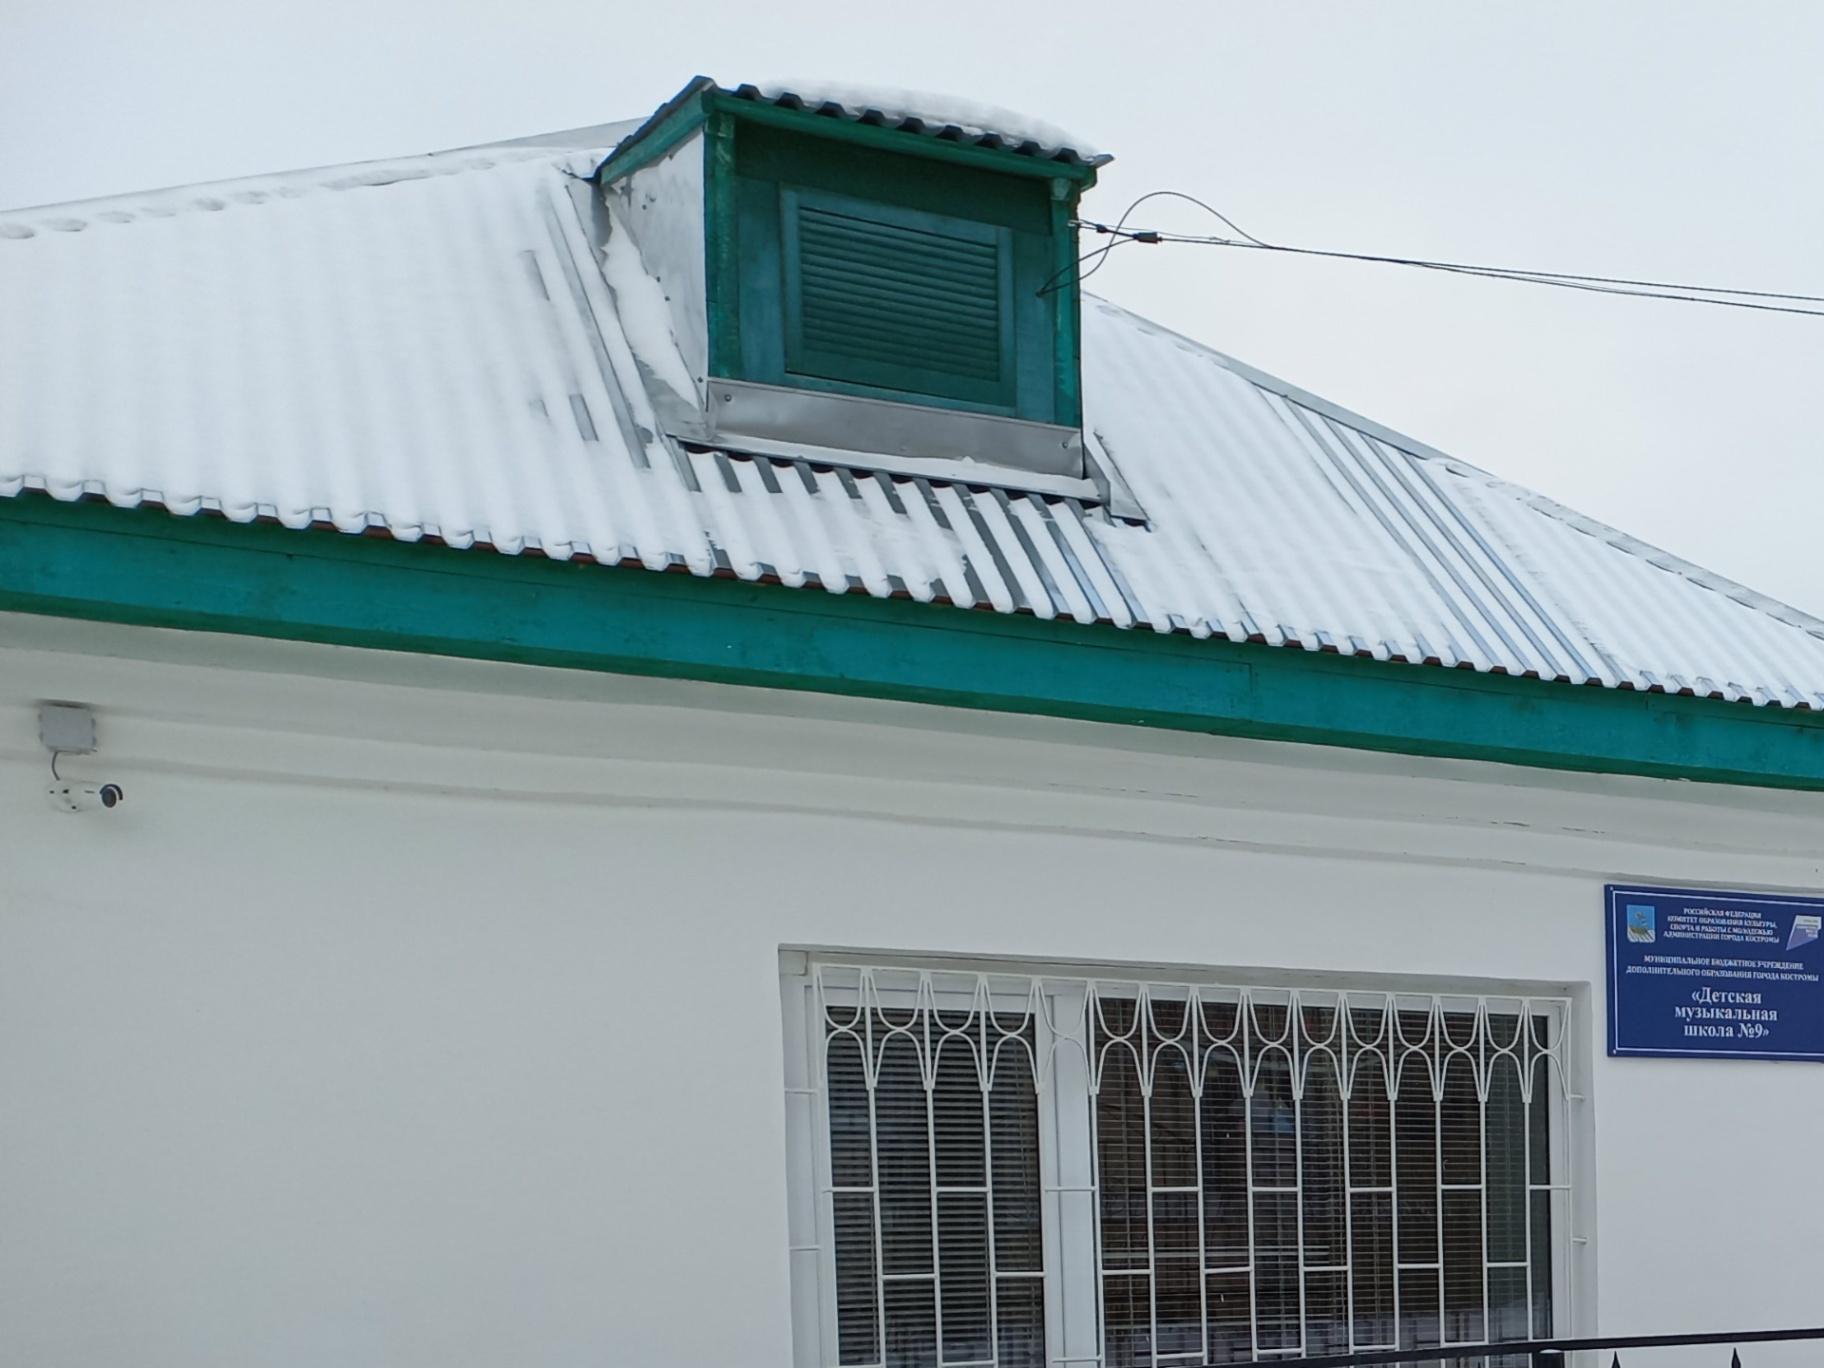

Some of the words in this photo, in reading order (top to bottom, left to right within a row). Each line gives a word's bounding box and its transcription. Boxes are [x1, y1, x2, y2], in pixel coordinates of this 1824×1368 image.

[1667, 916, 1698, 924] КОМИТЕТ
[1683, 908, 1724, 917] РОССИЙСКАЯ
[1725, 911, 1761, 919] ФЕДЕРАЦИЯ
[1670, 923, 1695, 931] СПОРТА
[1701, 925, 1726, 933] РАБОТЫ
[1663, 931, 1720, 940] АДМИНИСТРАЦИИ
[1720, 933, 1745, 942] ГОРОДА
[1745, 935, 1780, 944] КОСТРОМЫ
[1644, 955, 1710, 966] МУНИЦИПАЛЬНОЕ
[1711, 958, 1756, 968] БЮДЖЕТНОЕ
[1756, 961, 1804, 970] УЧРЕЖДЕНИЕ
[1626, 965, 1700, 977] ДОПОЛНИТЕЛЬНОГО
[1752, 972, 1780, 980] ГОРОДА
[1780, 973, 1819, 982] КОСТРОМЫ
[1692, 986, 1762, 1005] «Детская
[1674, 1006, 1777, 1022] музыкальная
[1684, 1025, 1734, 1038] школа
[1737, 1022, 1770, 1039] №9»
